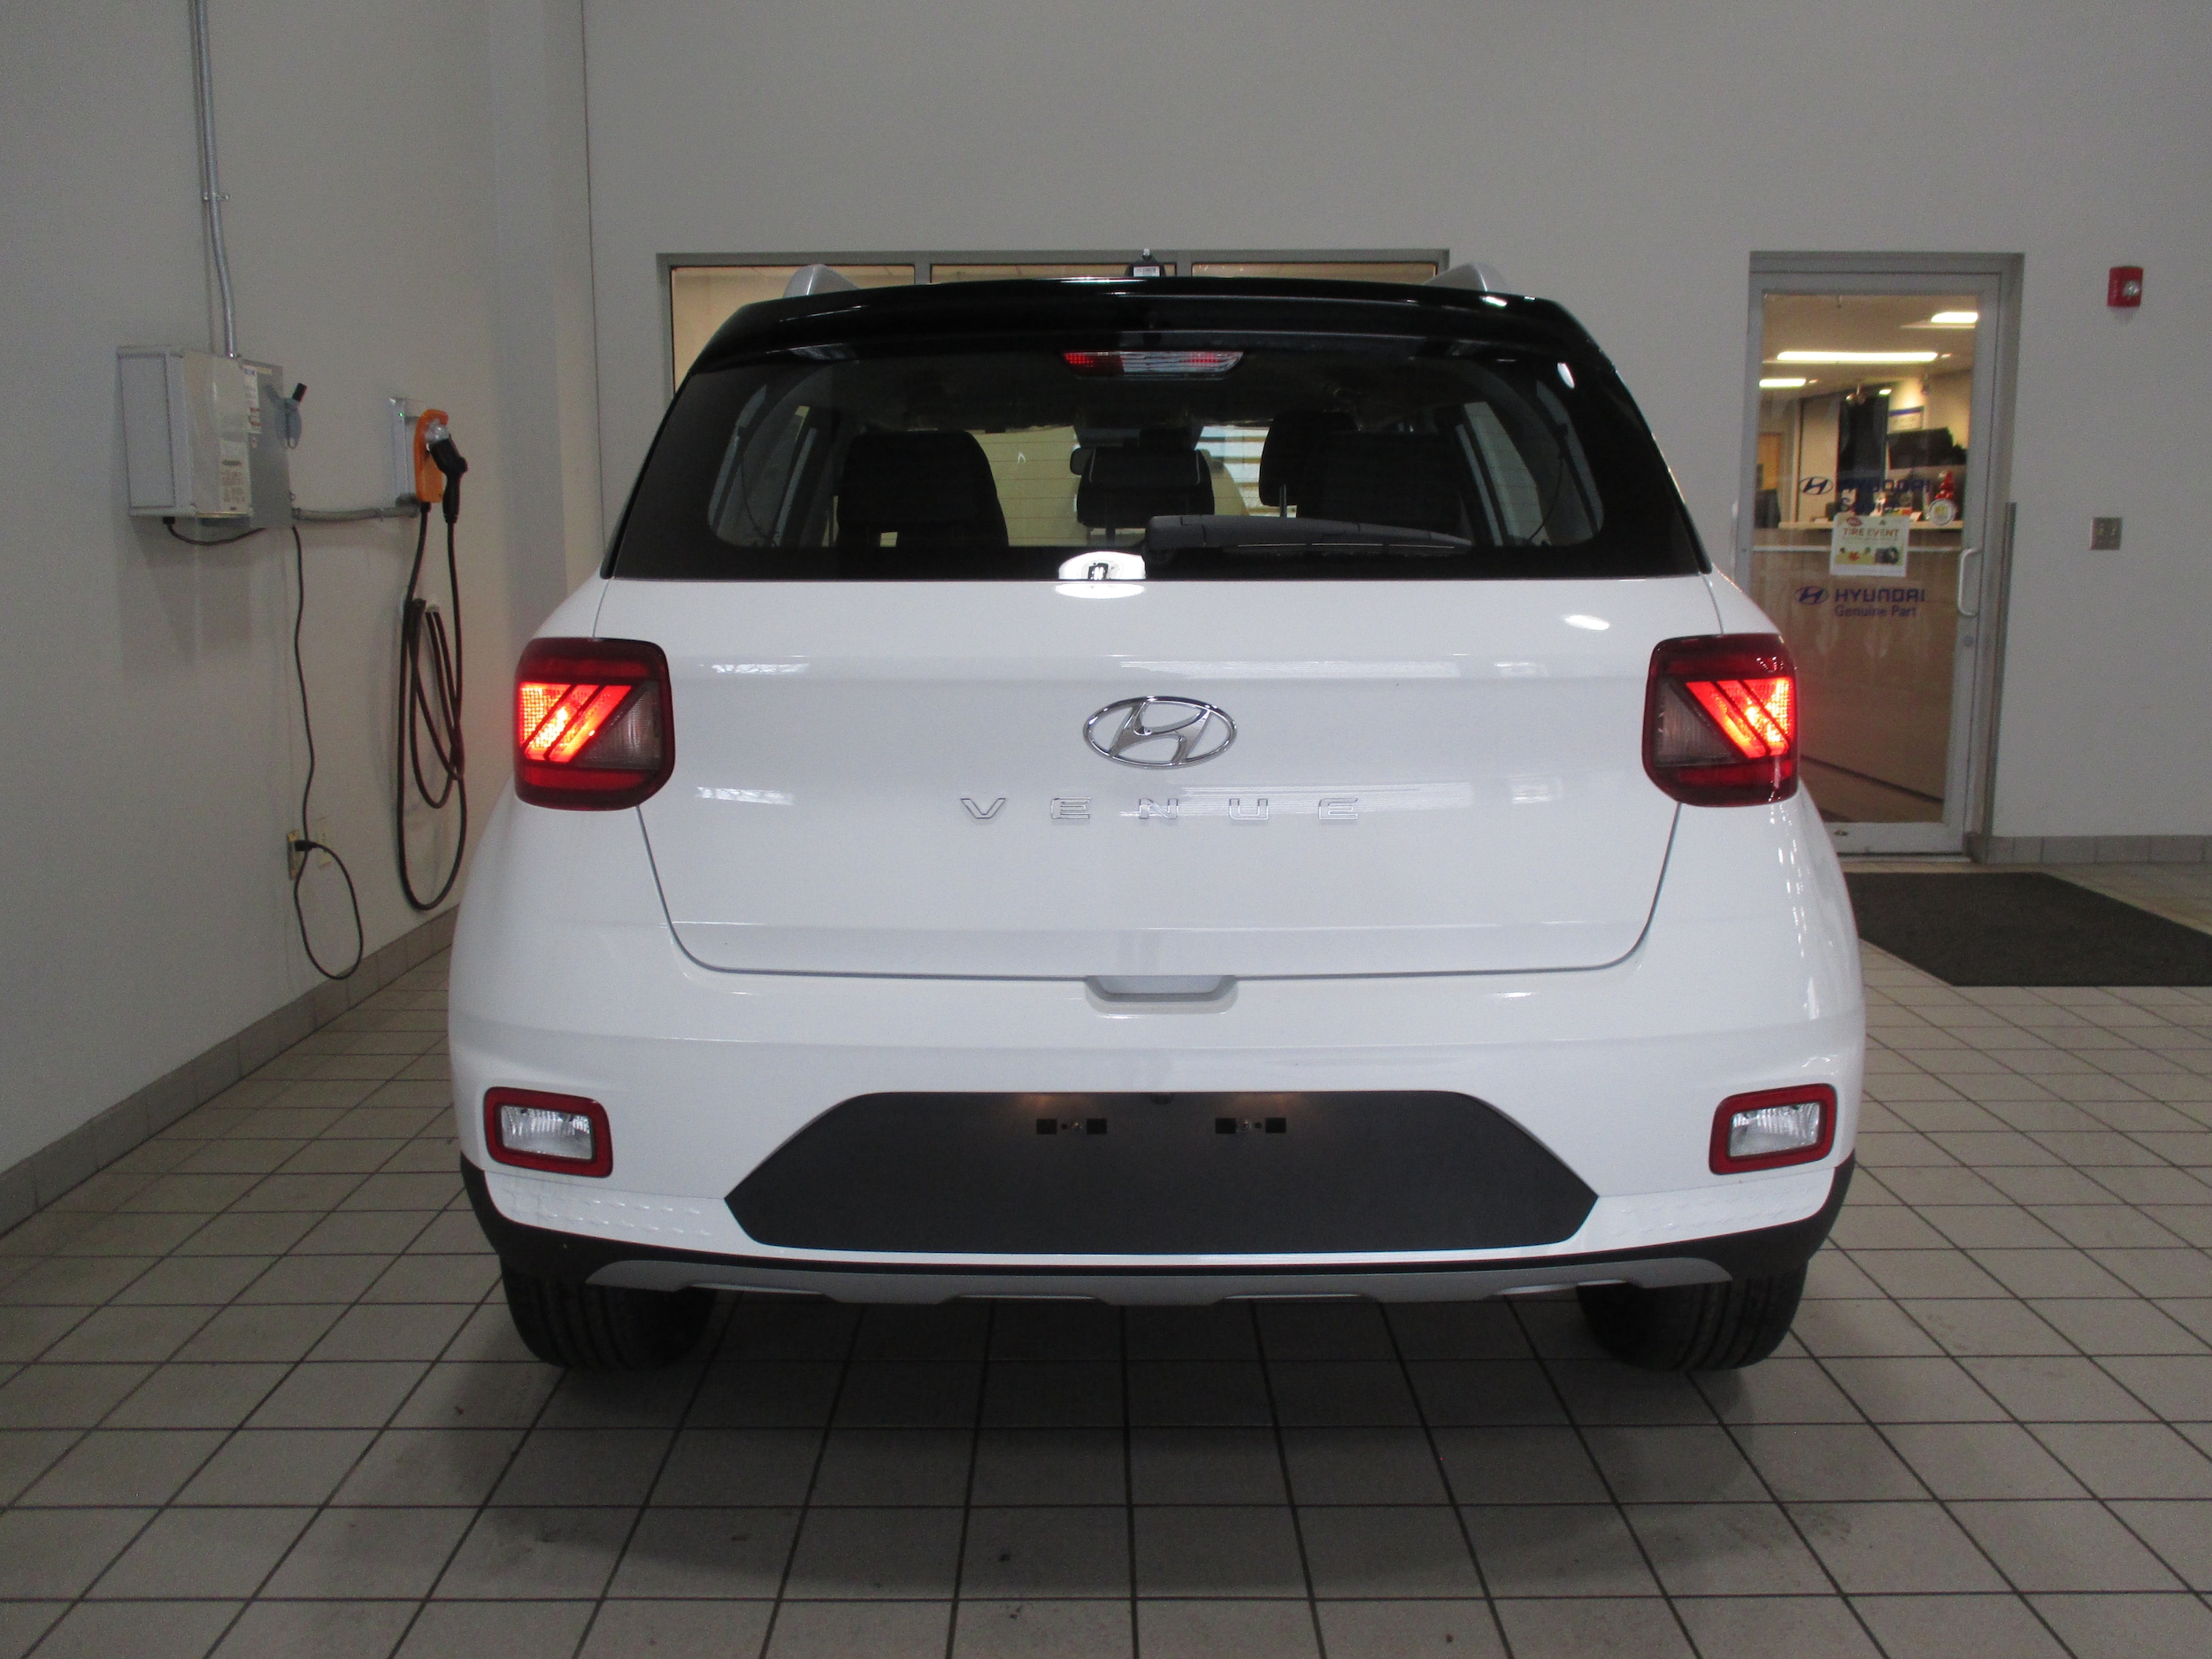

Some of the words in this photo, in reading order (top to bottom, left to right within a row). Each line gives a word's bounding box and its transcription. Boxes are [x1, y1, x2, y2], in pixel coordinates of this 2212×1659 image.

[1842, 527, 1863, 537] TIRE
[1867, 527, 1899, 537] EVENT
[1834, 588, 1925, 603] HYUNDAI
[1834, 604, 1887, 618] Genuine
[960, 797, 1358, 819] VENUE
